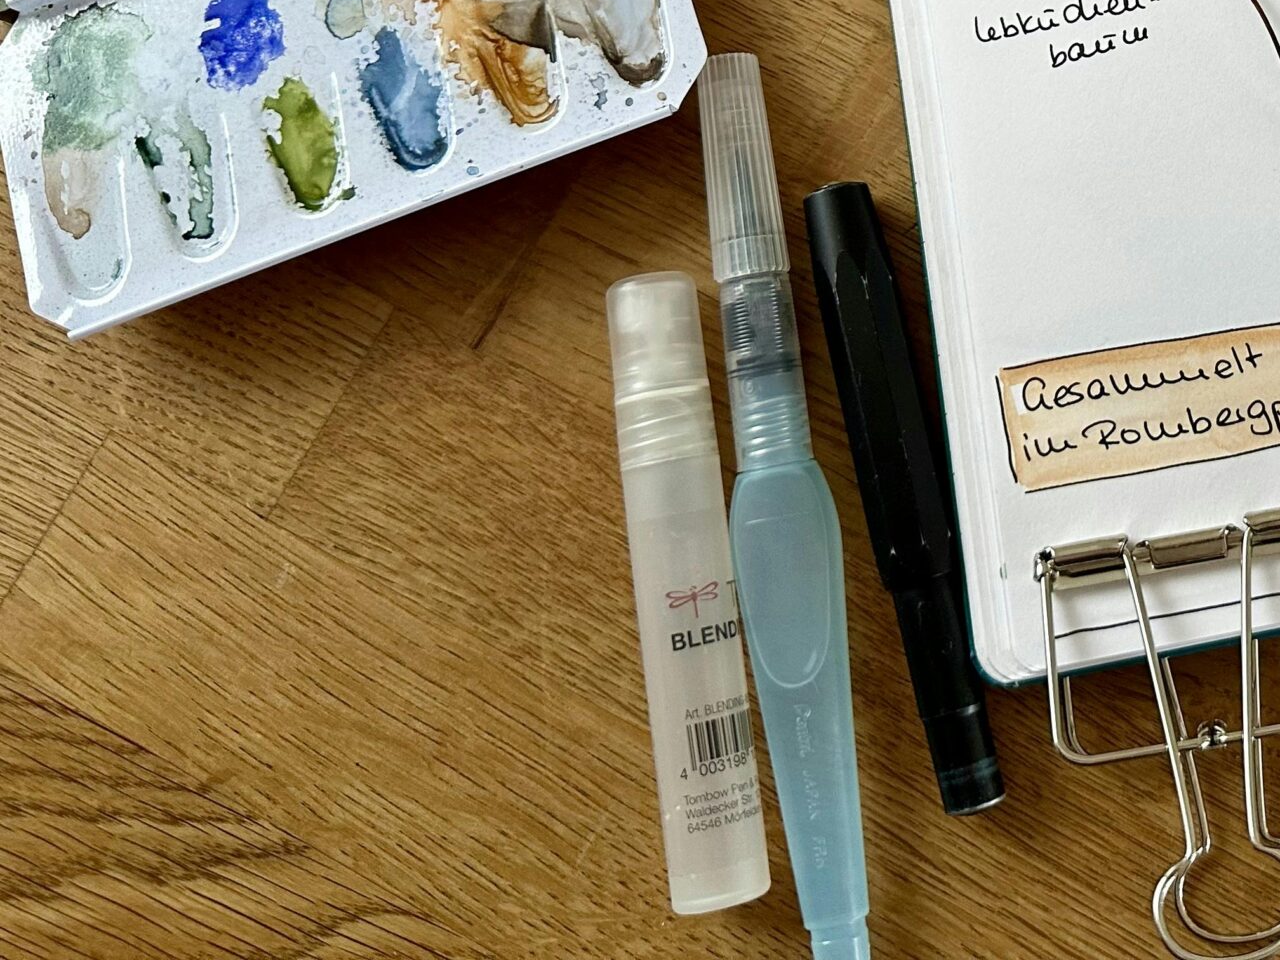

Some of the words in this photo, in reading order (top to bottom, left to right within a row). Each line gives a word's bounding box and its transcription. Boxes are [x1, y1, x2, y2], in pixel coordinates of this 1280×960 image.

[1020, 341, 1263, 414] Gesammelt
[1022, 432, 1078, 463] im
[687, 816, 722, 834] 64546
